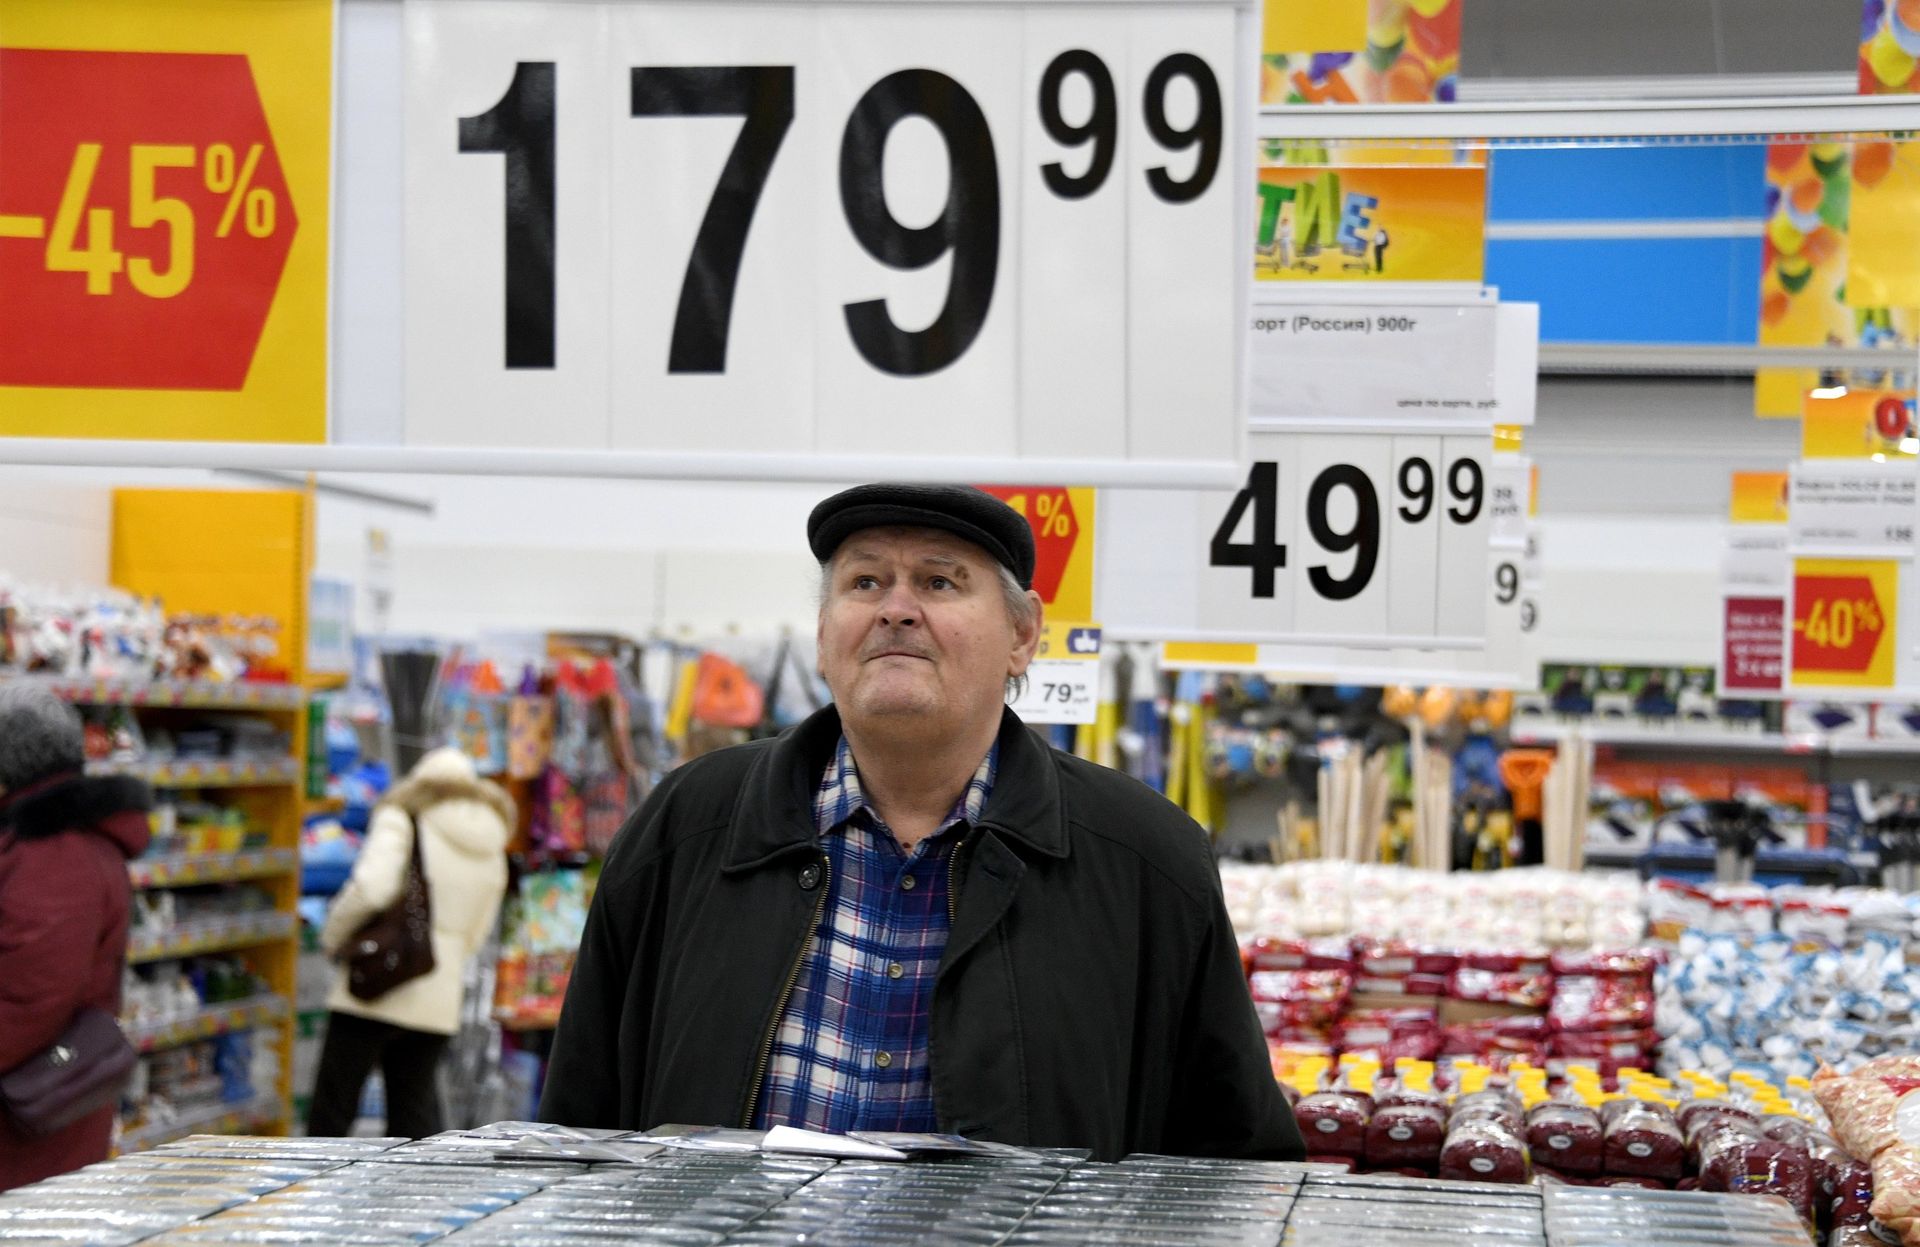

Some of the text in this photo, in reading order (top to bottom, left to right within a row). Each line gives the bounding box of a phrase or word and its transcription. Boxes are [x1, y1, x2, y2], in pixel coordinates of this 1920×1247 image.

[0, 142, 276, 298] -45%
[458, 49, 1224, 378] 179 99
[1251, 315, 1416, 334] орт (Россия) 900г
[1209, 456, 1484, 601] 49 99
[1793, 600, 1878, 648] -40%
[1043, 683, 1072, 703] 79
